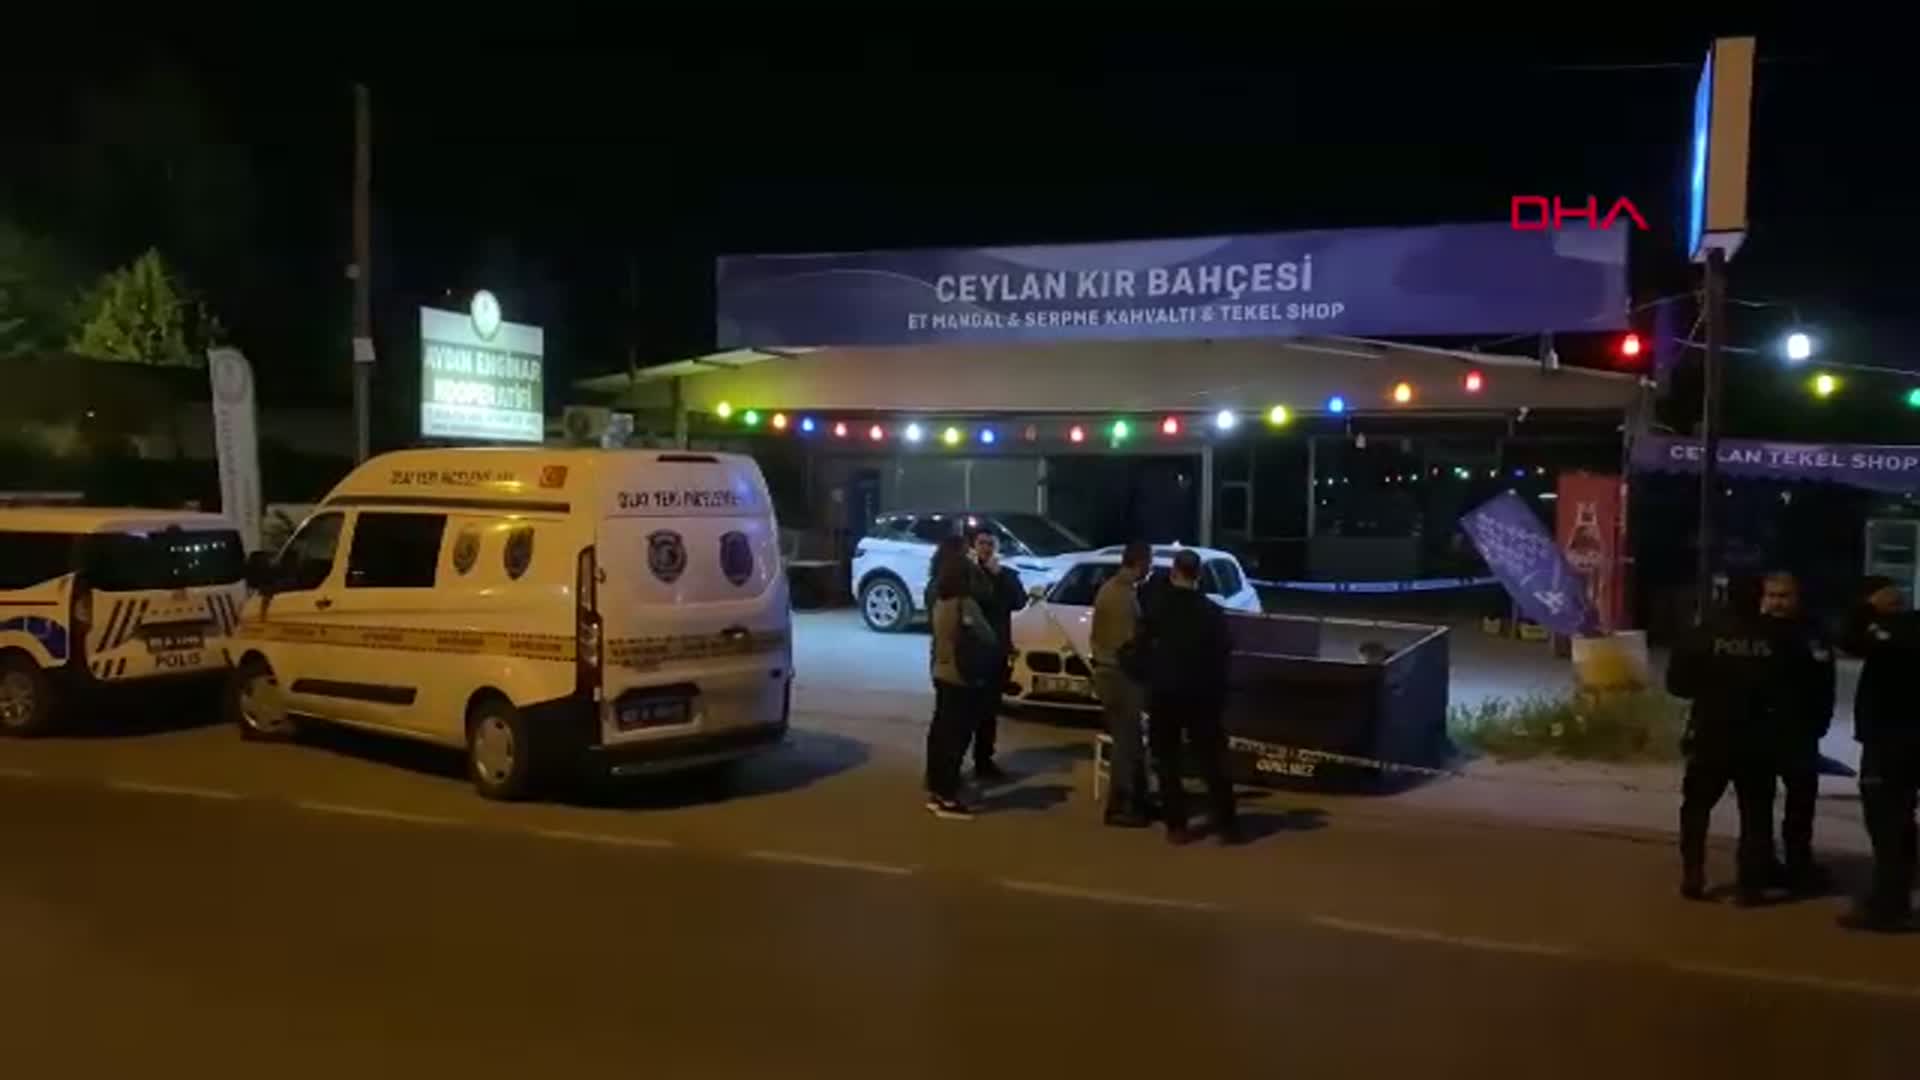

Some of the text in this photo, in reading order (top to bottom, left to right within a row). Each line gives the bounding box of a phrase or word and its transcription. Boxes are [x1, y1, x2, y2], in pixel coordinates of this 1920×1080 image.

[936, 253, 1312, 302] CEYLAN KIR BAHÇESİ
[908, 313, 928, 329] ET
[1007, 311, 1021, 328] &
[1025, 308, 1099, 328] SERPME
[1105, 305, 1196, 325] KAHVALTI
[1200, 305, 1216, 322] &
[1219, 303, 1283, 321] TEKEL
[1286, 302, 1345, 320] SHOP
[1768, 450, 1845, 468] TEKEL
[1851, 452, 1918, 472] SHOP
